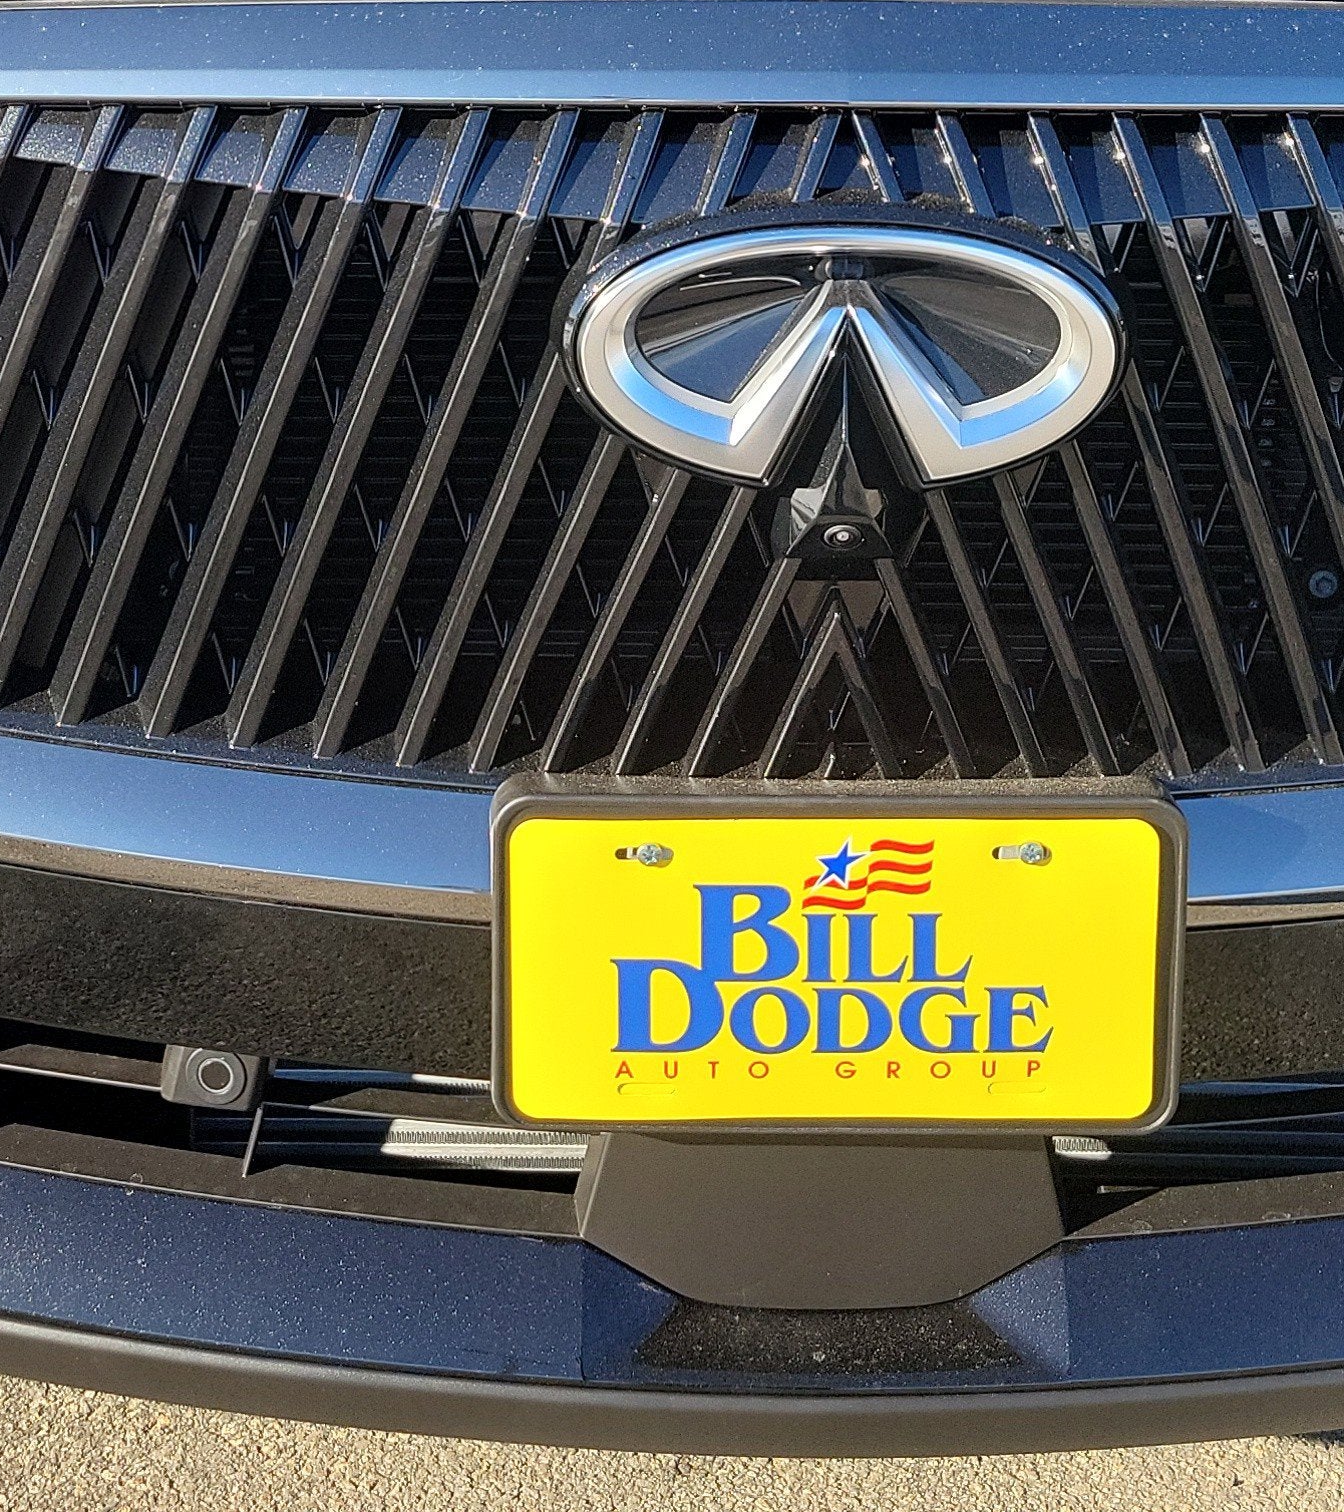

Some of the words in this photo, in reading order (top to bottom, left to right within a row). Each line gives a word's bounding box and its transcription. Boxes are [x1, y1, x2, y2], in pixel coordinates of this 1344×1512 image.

[693, 884, 974, 983] BILL
[610, 959, 1054, 1054] DODGE
[614, 1059, 770, 1079] AUTO
[835, 1059, 1042, 1080] GROUP
